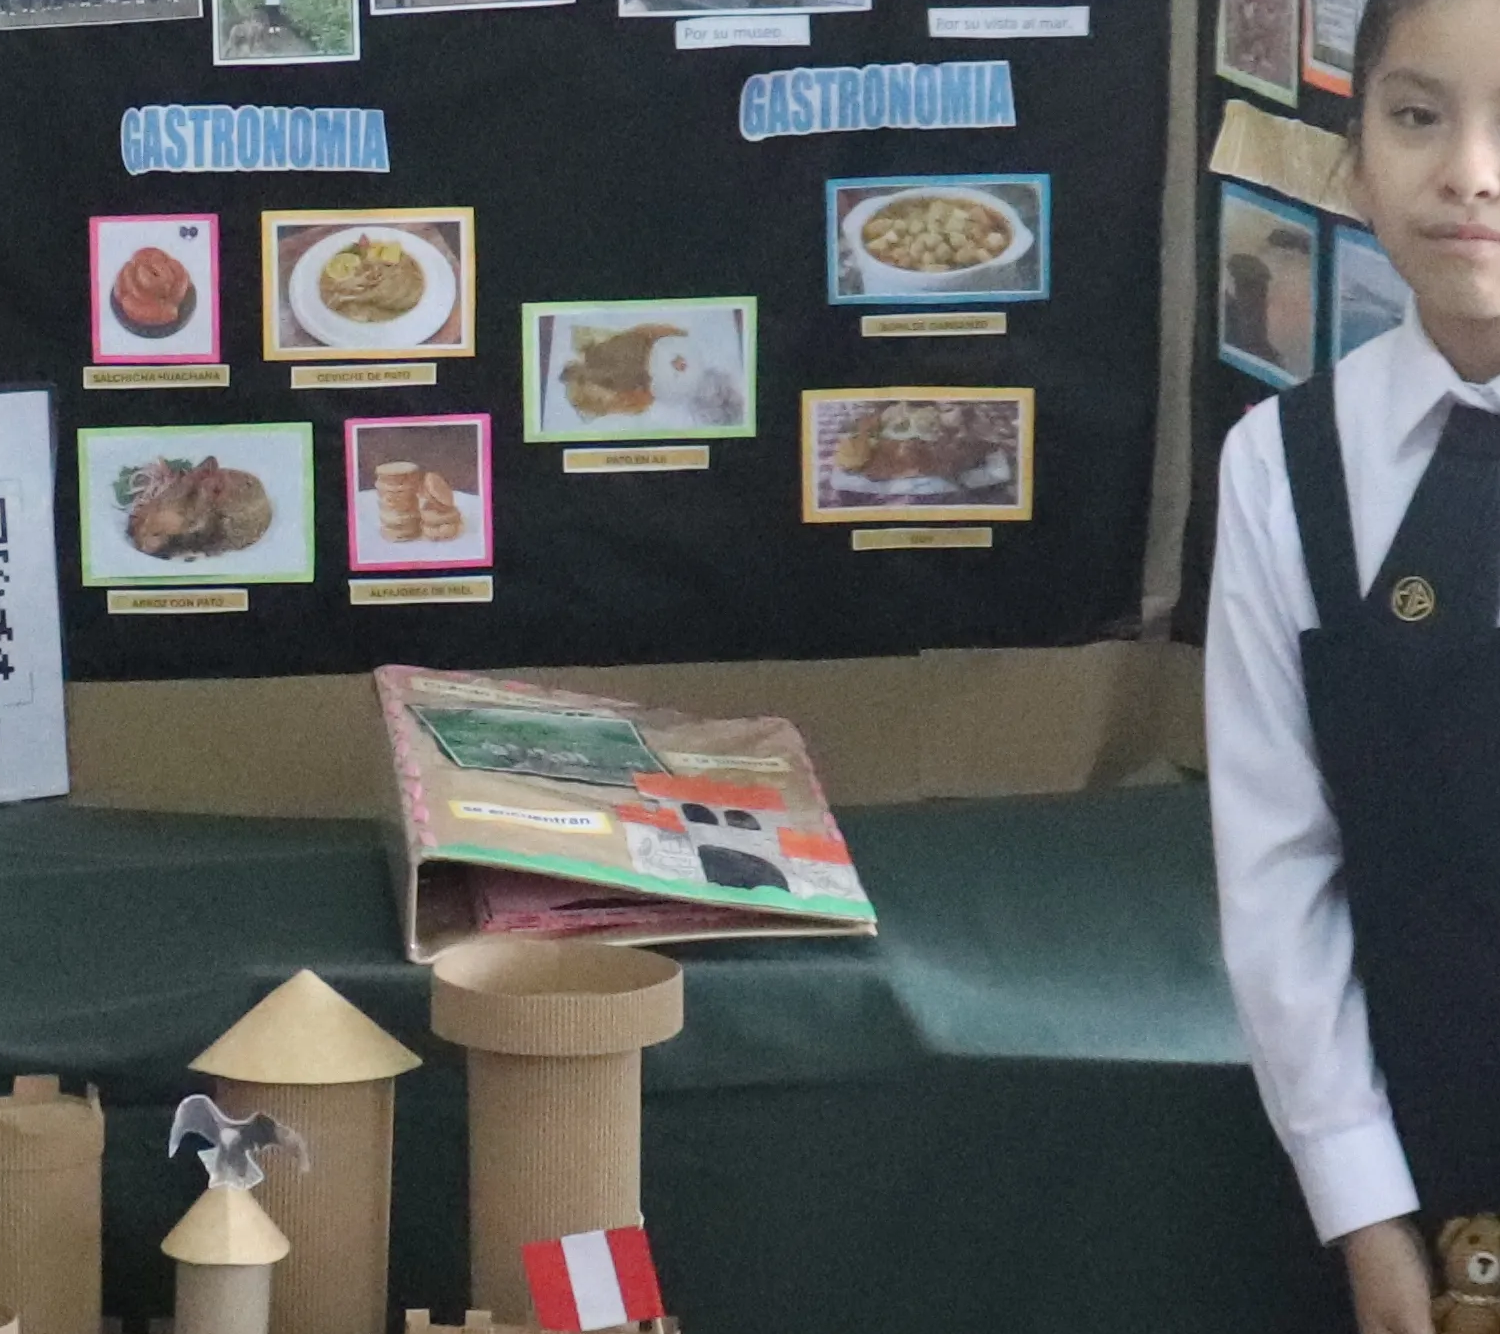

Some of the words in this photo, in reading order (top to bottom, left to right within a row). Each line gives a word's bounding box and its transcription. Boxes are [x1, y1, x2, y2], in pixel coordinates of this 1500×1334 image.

[684, 27, 708, 40] Por
[743, 64, 1010, 136] GASTRONOMIA
[123, 106, 386, 172] GASTRONOMIA
